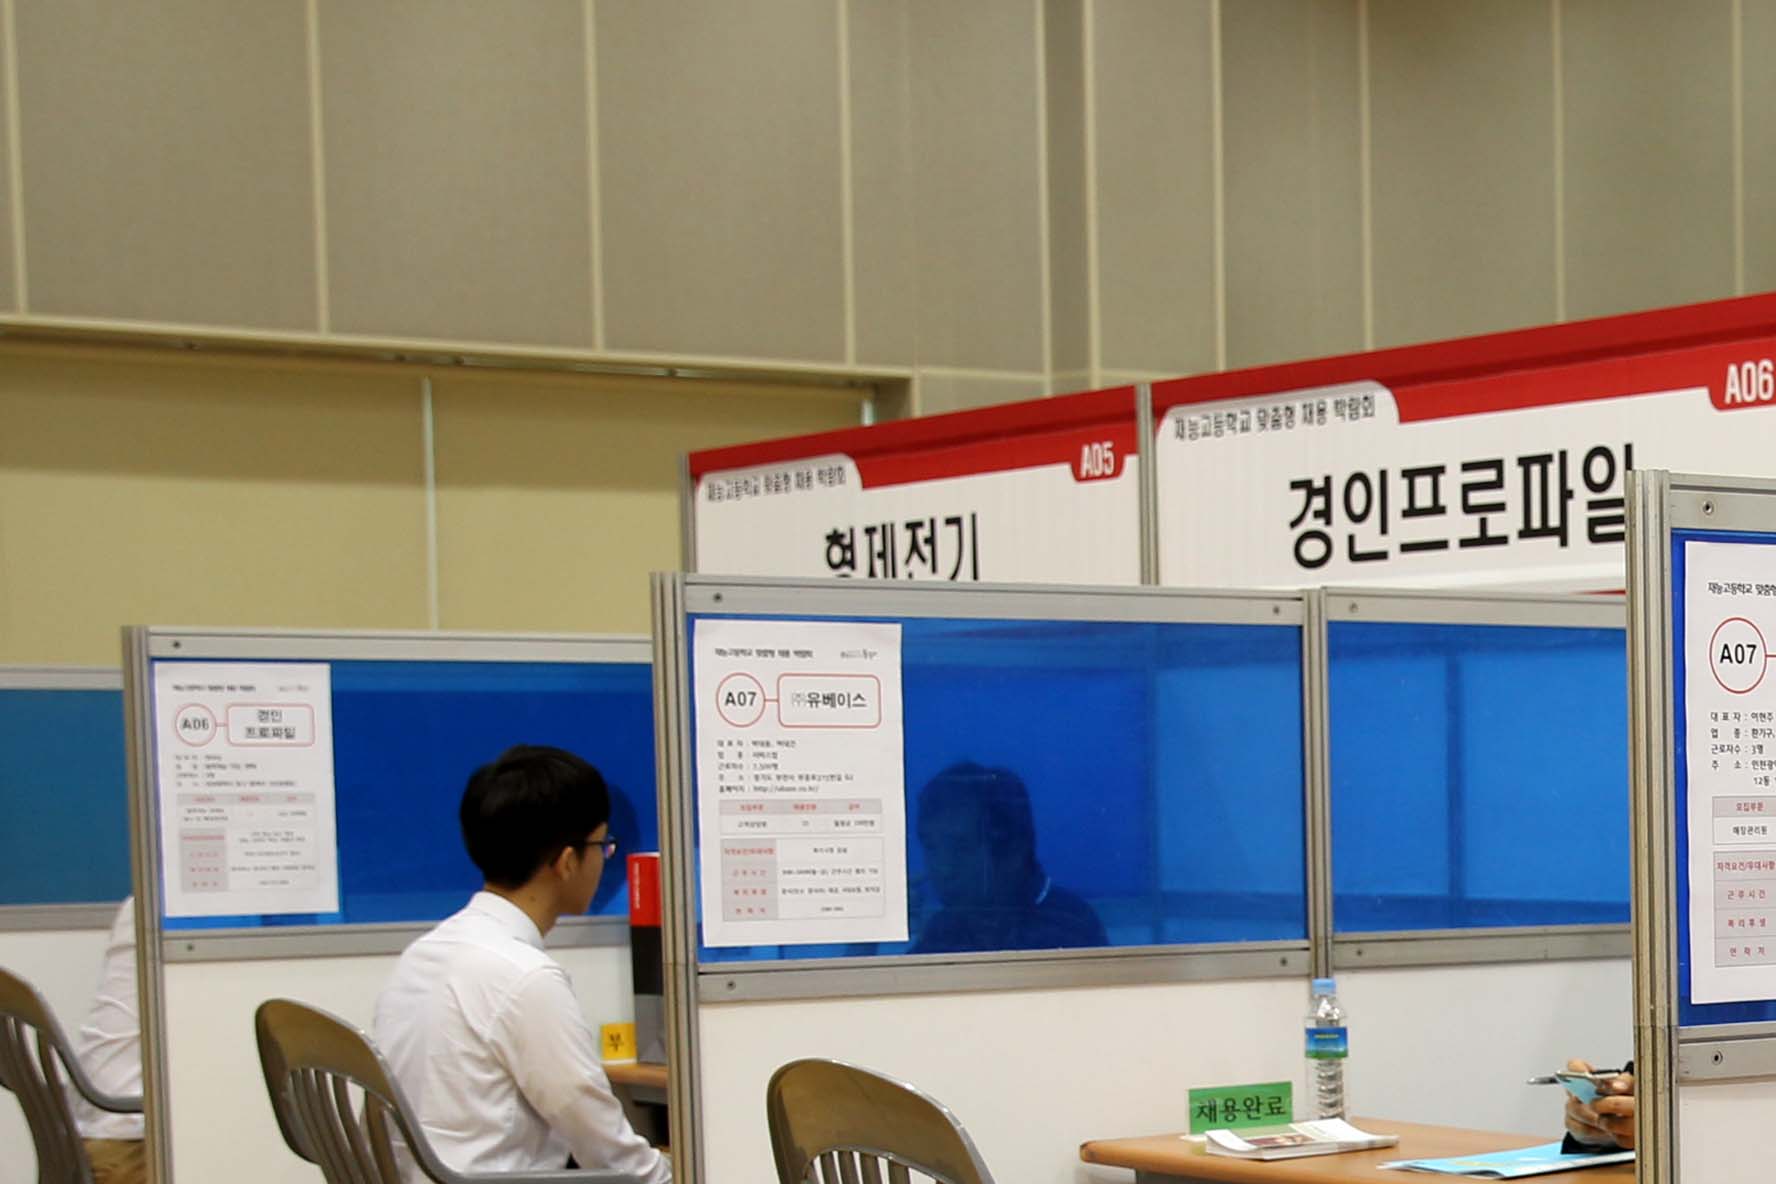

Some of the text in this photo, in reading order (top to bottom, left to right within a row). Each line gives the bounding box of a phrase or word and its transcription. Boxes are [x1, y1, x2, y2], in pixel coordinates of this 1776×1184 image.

[1724, 359, 1775, 404] A06
[1175, 409, 1251, 441] 재능고등학교
[1302, 399, 1327, 426] 채용
[1334, 395, 1375, 420] 박람회
[1080, 440, 1114, 478] A05
[1289, 443, 1633, 569] 경인프로파일
[1720, 643, 1757, 664] A07
[725, 691, 757, 707] A07
[182, 718, 210, 730] A06
[1195, 1095, 1286, 1123] 채용완료
